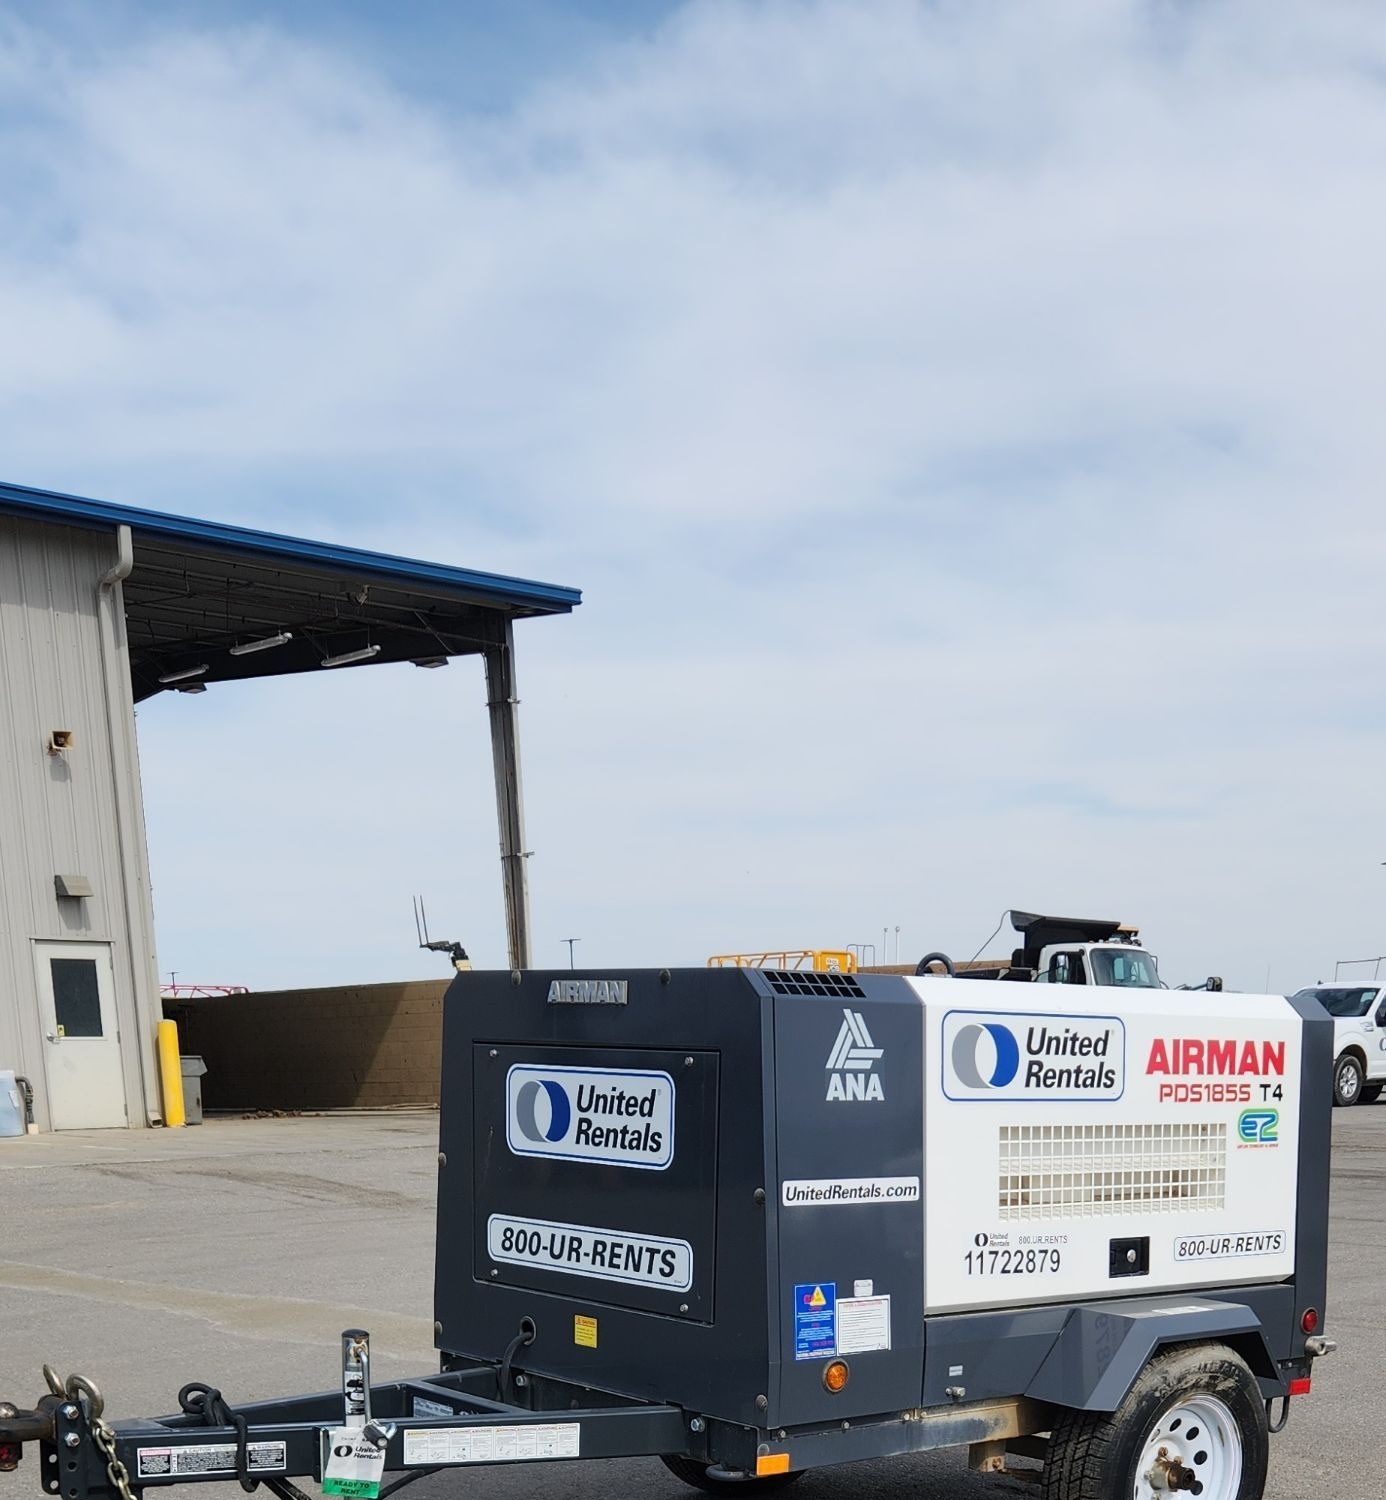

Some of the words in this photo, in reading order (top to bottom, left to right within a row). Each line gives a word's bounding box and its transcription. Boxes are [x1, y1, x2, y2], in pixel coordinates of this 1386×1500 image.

[547, 980, 628, 1004] AIRMAN
[1026, 1027, 1110, 1057] United
[1145, 1038, 1285, 1076] AIRMAN
[825, 1073, 885, 1101] ANA
[1025, 1060, 1116, 1089] Rentals
[576, 1084, 657, 1118] United
[1159, 1083, 1251, 1103] PDS185S
[1259, 1083, 1283, 1102] T4
[575, 1117, 663, 1153] Rentals
[785, 1184, 917, 1202] UnitedRentals.com
[501, 1227, 676, 1278] 800-UR-RENTS
[1178, 1234, 1282, 1257] 800-UR-RENTS
[964, 1249, 1061, 1275] 11722879
[334, 1480, 358, 1488] READY
